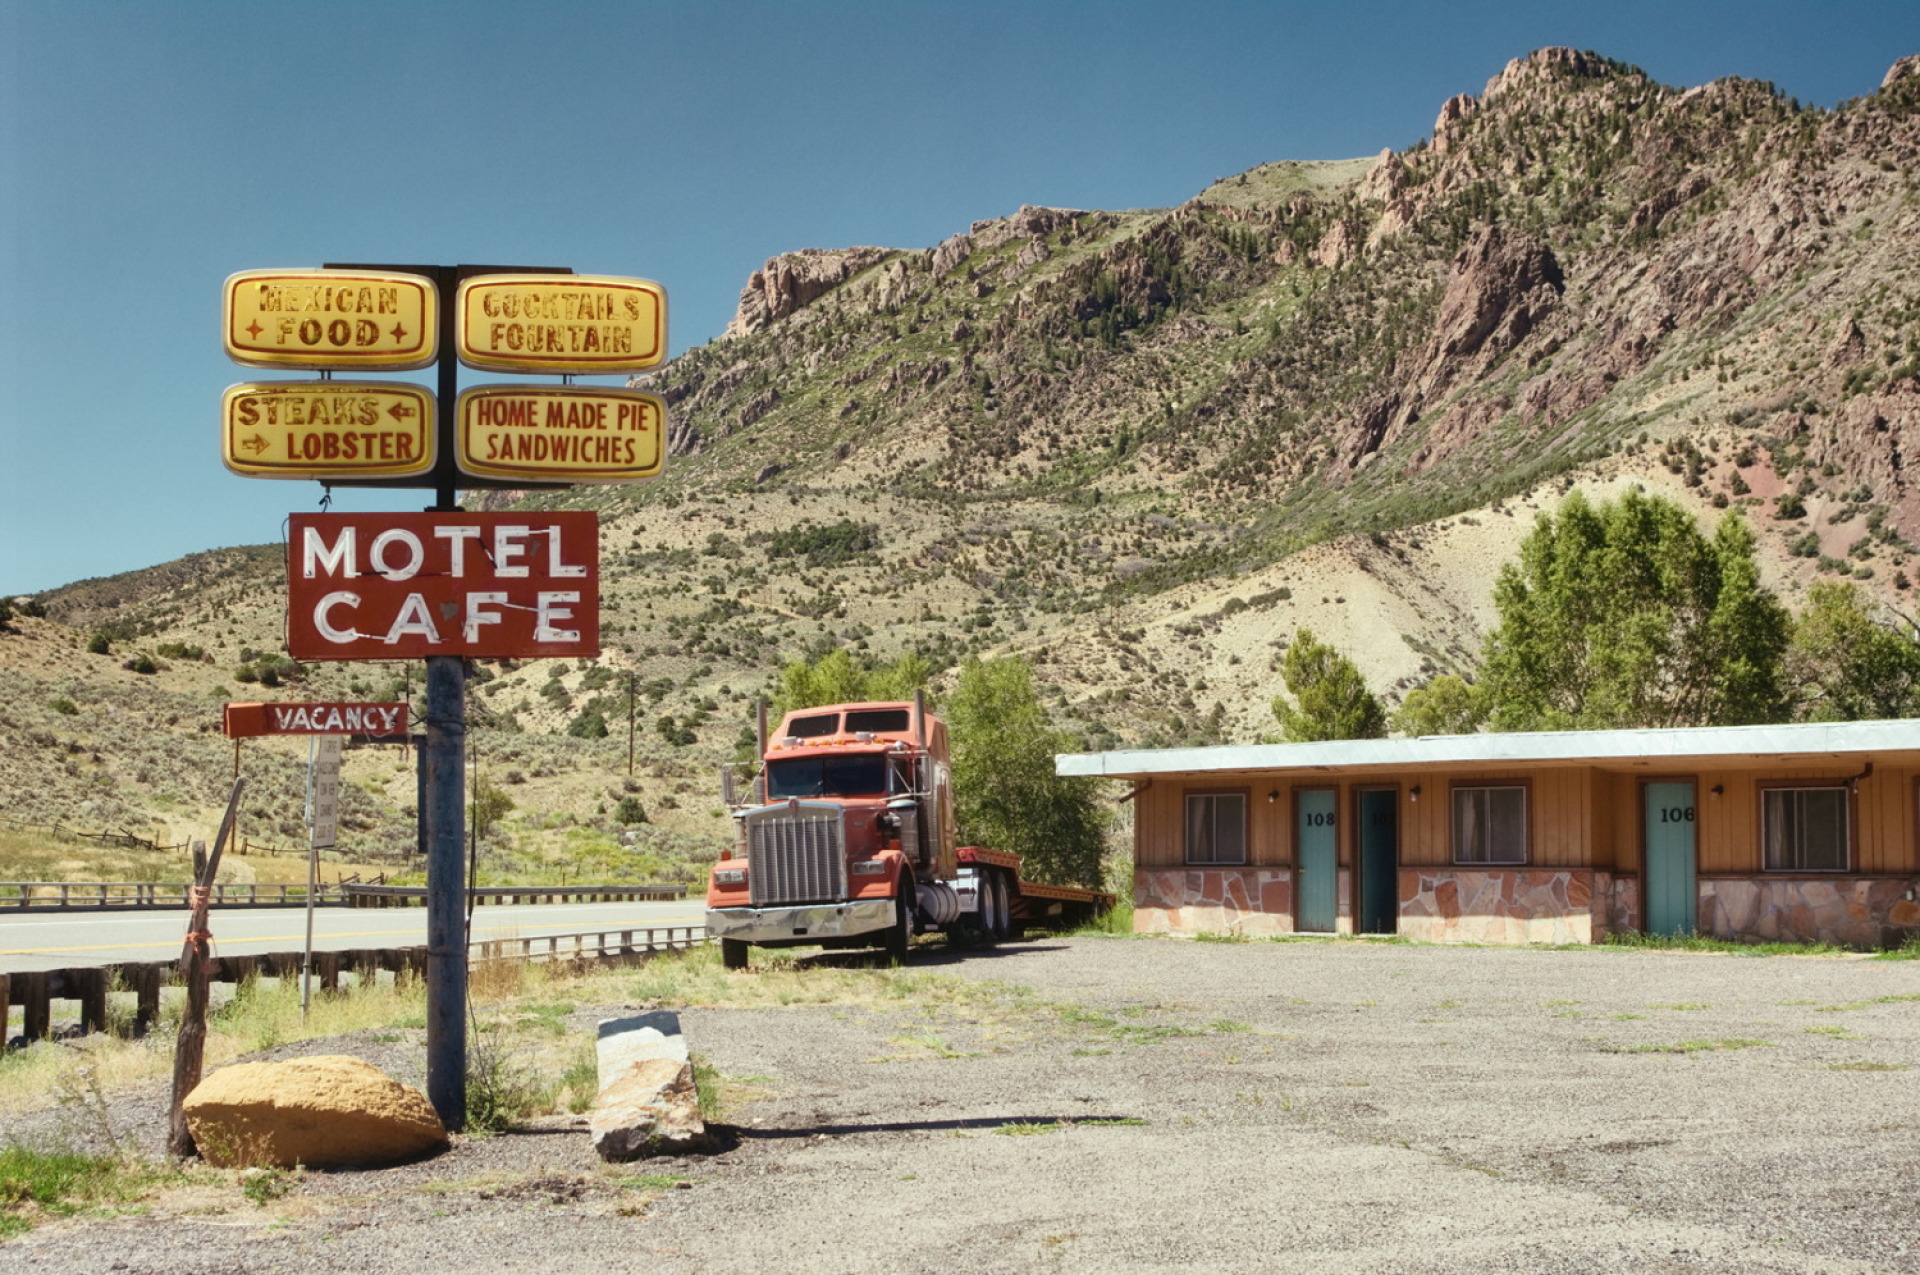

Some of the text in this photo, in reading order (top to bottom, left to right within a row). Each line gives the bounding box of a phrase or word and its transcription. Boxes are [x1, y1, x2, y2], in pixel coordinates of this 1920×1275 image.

[259, 285, 398, 314] MEXICAN
[483, 291, 639, 321] COCKTAILS
[276, 318, 380, 347] FOOD
[490, 323, 631, 353] FOUNTAIN
[238, 397, 379, 426] STEAKS
[477, 399, 648, 431] HOME MADE PIE
[287, 431, 413, 460] LOBSTER
[486, 433, 636, 464] SANDWICHES
[303, 525, 587, 581] MOTEL
[313, 591, 581, 644] CAFE
[274, 706, 399, 731] VACANCY
[1306, 813, 1335, 827] 108
[1661, 808, 1695, 823] 106
